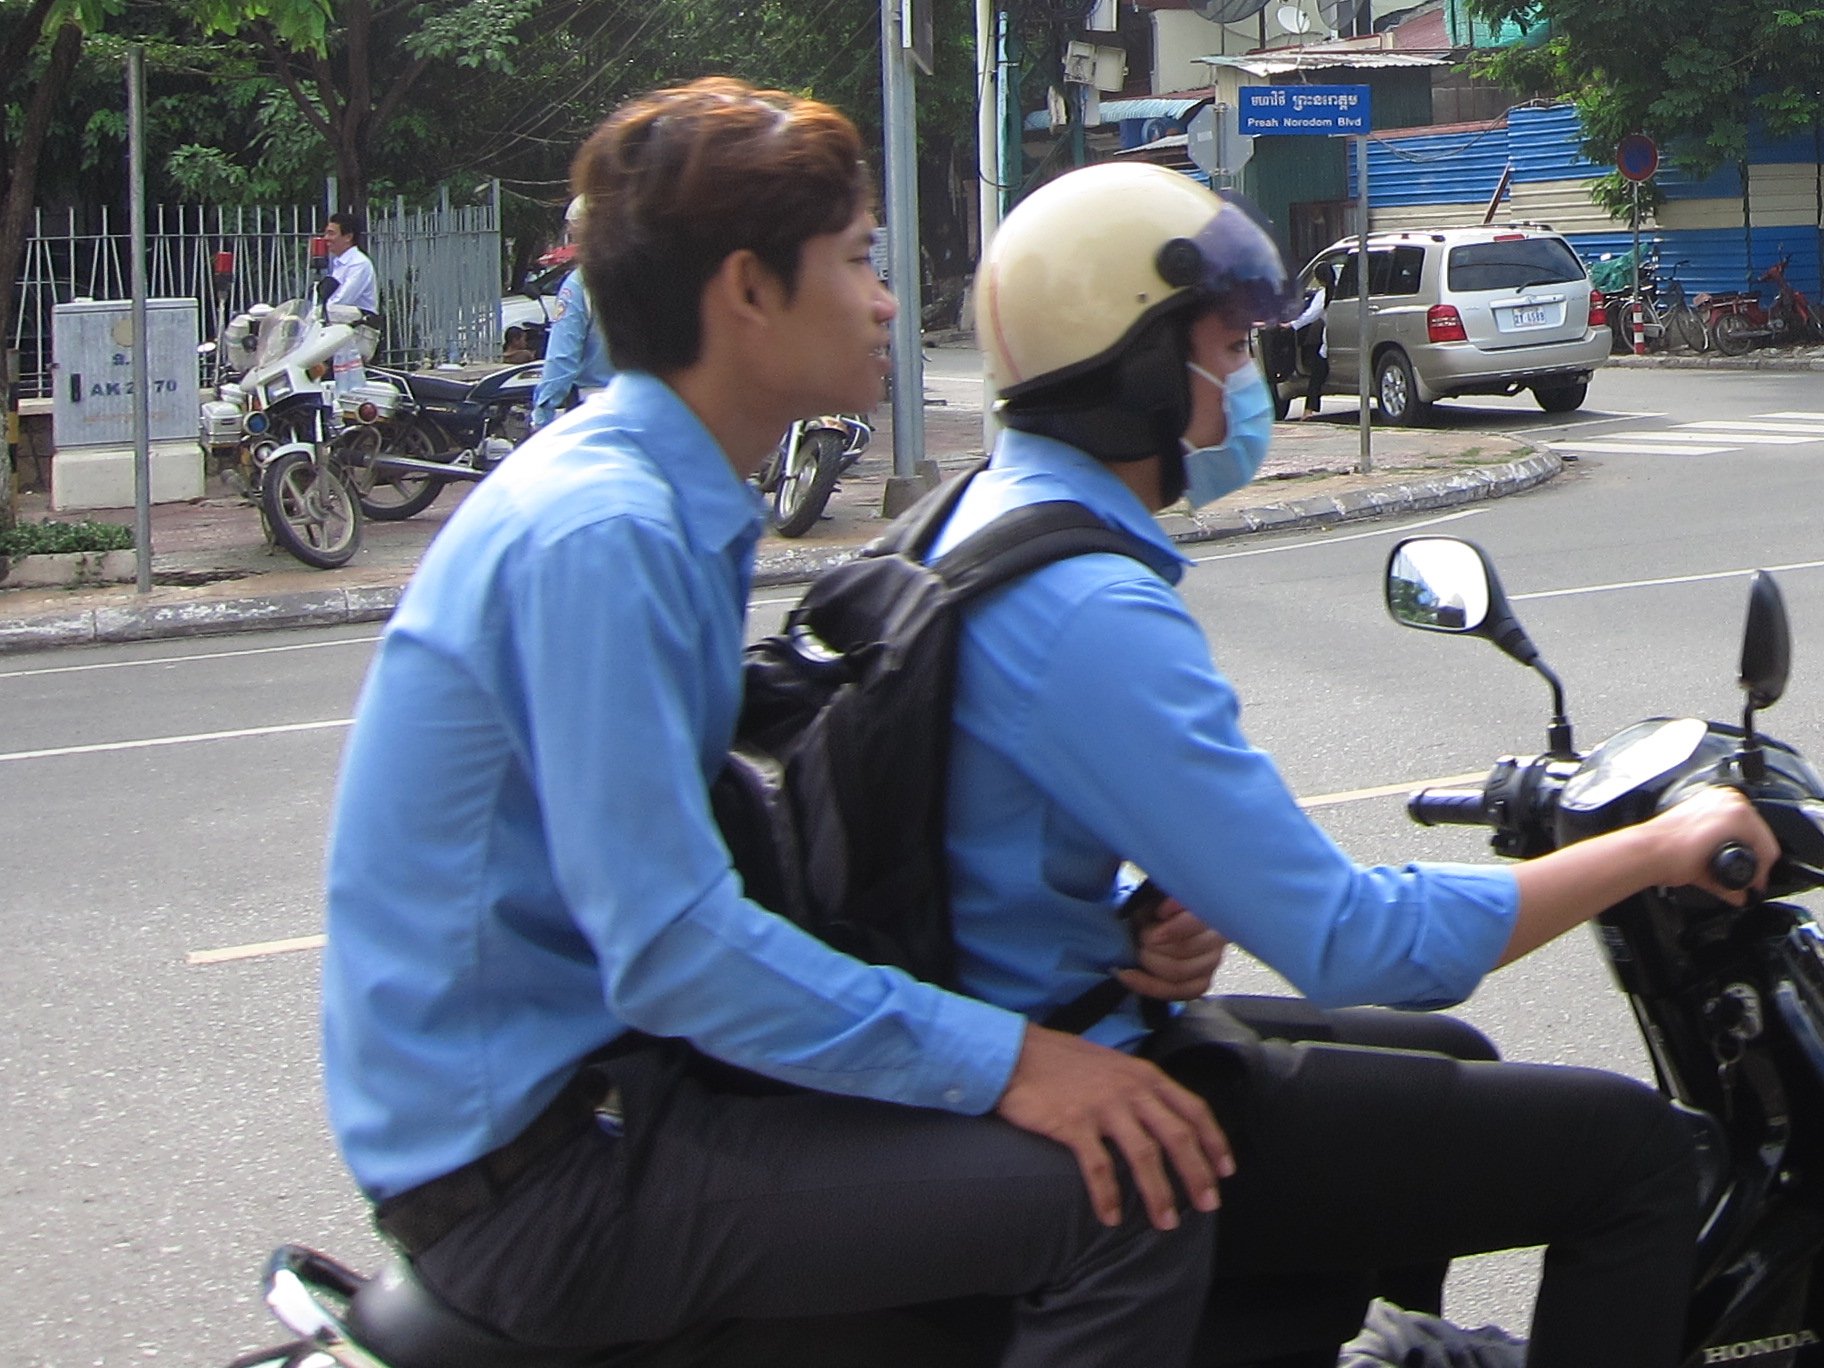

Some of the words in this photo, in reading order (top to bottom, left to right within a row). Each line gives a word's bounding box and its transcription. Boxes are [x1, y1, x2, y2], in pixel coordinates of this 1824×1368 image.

[1247, 117, 1279, 127] Preah
[1283, 117, 1332, 127] Norodom
[1337, 117, 1362, 127] Blvd
[1703, 1330, 1820, 1364] HONDA
